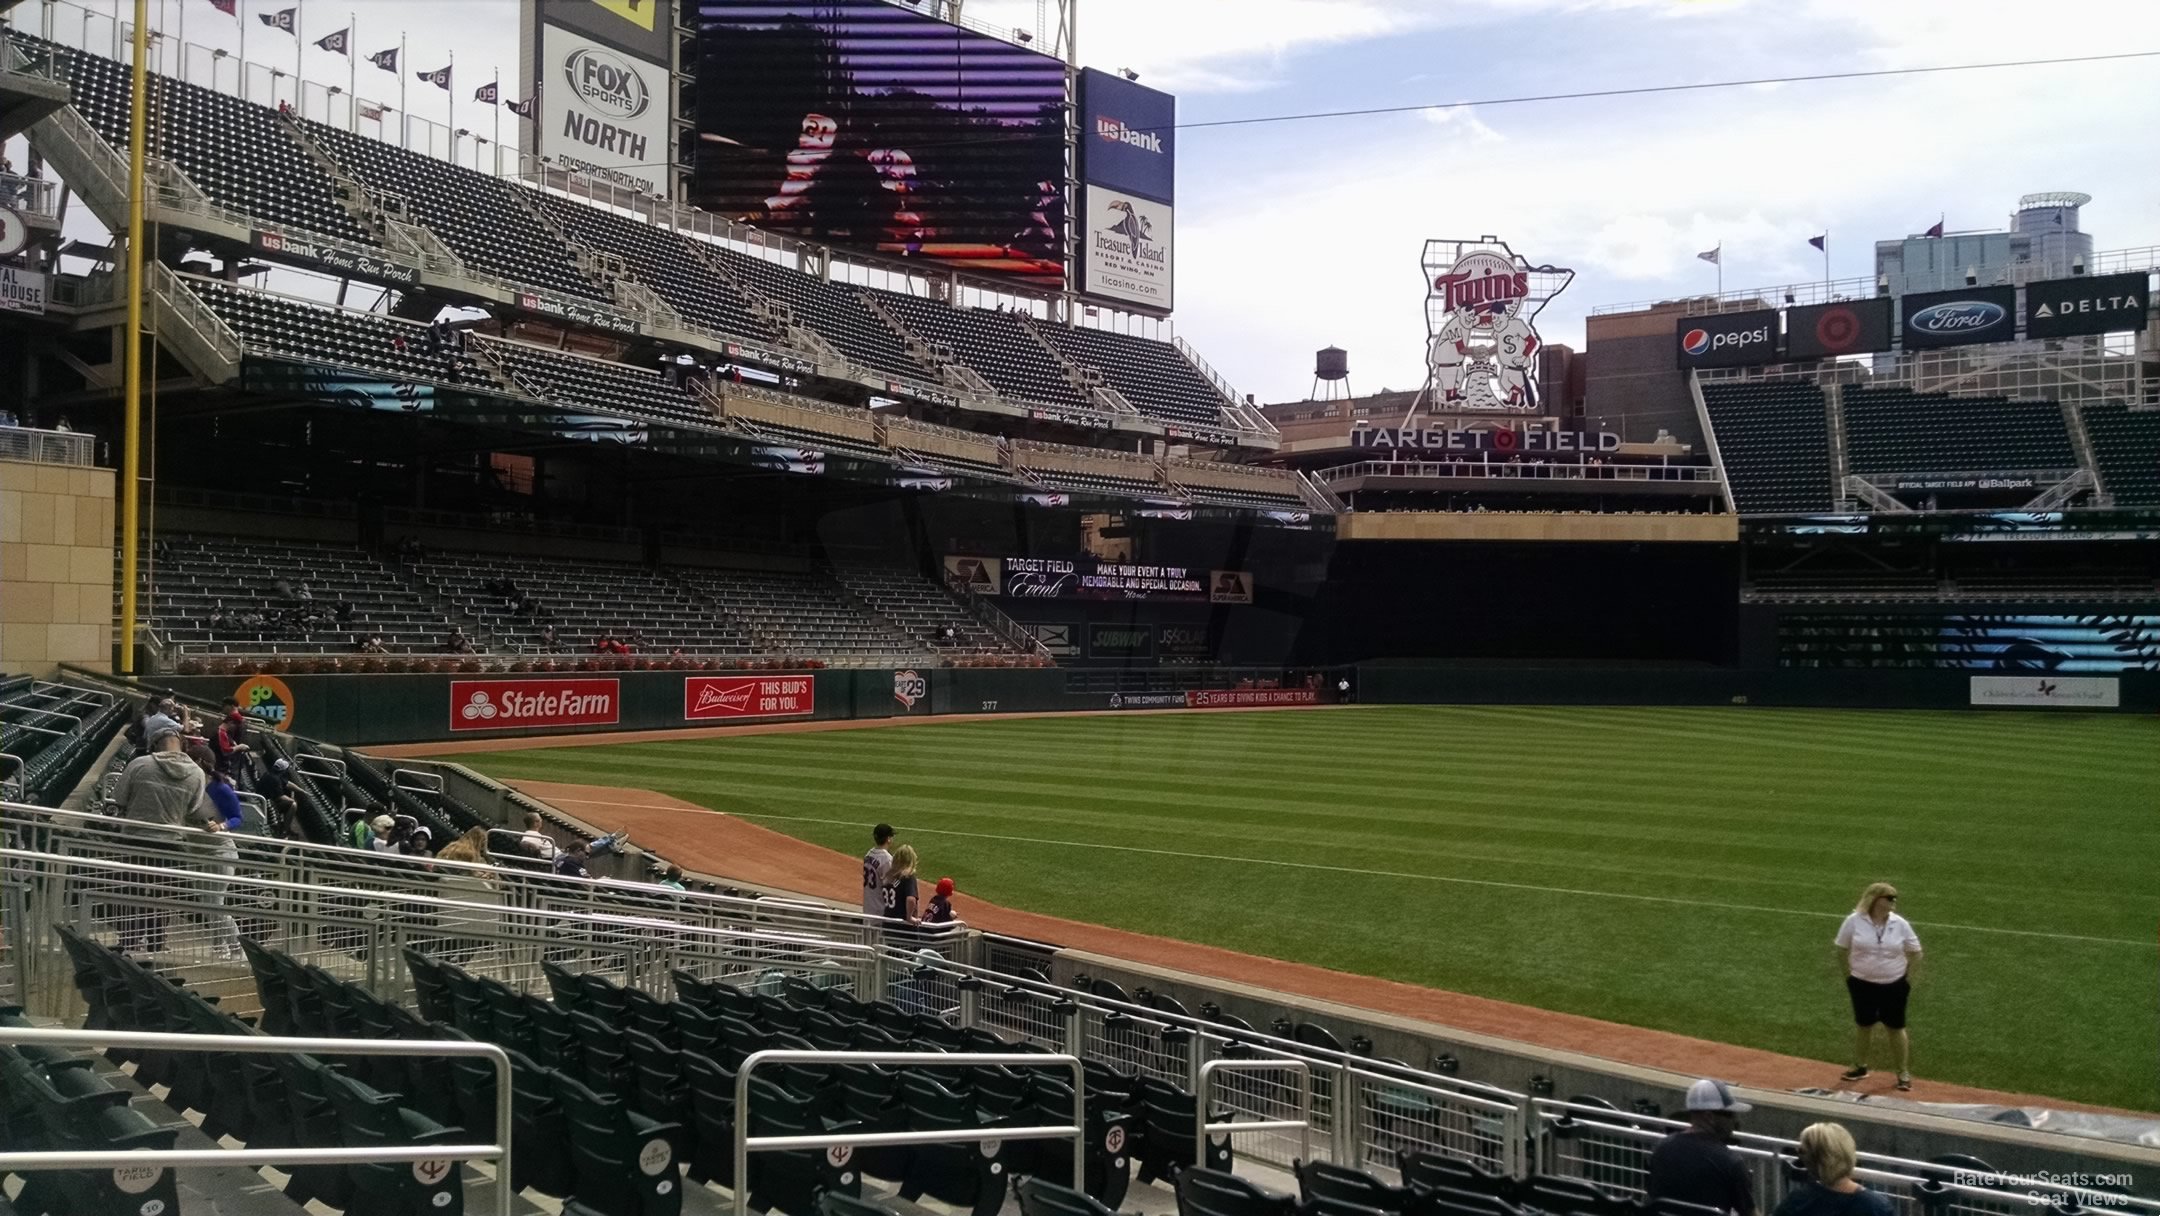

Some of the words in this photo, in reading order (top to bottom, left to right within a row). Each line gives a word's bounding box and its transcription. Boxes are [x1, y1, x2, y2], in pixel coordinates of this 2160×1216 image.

[584, 56, 632, 99] FOX
[583, 85, 632, 111] SPORTS
[564, 110, 647, 161] NORTH
[1094, 231, 1131, 255] Treasure
[1139, 243, 1165, 263] Island
[322, 249, 353, 269] Home
[358, 258, 379, 275] Run
[383, 264, 412, 282] Porch
[1095, 252, 1124, 262] RESORT
[1136, 261, 1164, 271] CASINO
[1102, 275, 1157, 295] ticasino.com
[1435, 267, 1529, 313] Twins
[2060, 295, 2139, 315] DELTA
[567, 307, 590, 323] Home
[593, 313, 611, 327] Run
[612, 318, 635, 333] Porch
[1928, 308, 1985, 329] Ford
[1713, 326, 1768, 350] pepsi
[1352, 428, 1489, 449] TARGET
[1524, 431, 1622, 451] FIELD
[1991, 478, 2032, 489] Ballpark
[1006, 558, 1045, 572] TARGET
[1046, 560, 1073, 573] FIELD
[1097, 564, 1117, 576] MAKE
[1119, 565, 1136, 577] YOUR
[1137, 566, 1158, 577] EVENT
[1160, 567, 1165, 577] A
[1167, 568, 1187, 578] TRULY
[1008, 573, 1079, 597] Events
[1082, 576, 1124, 588] MEMORABLE
[1126, 578, 1139, 588] AND
[1141, 579, 1168, 590] SPECIAL
[1092, 631, 1146, 647] SUBWAY
[249, 686, 272, 705] go
[700, 690, 750, 704] Budweiser
[760, 682, 780, 695] THIS
[782, 681, 807, 695] BUD'S
[906, 680, 924, 696] 29
[760, 697, 777, 710] FOR
[779, 697, 798, 710] YOU.
[982, 701, 998, 710] 377
[1124, 696, 1140, 704] TWINS
[1142, 696, 1171, 704] COMMUNITY
[1196, 692, 1209, 705] 25
[1209, 693, 1228, 703] YEARS
[1229, 693, 1236, 702] OF
[1237, 693, 1254, 702] GIVING
[1255, 693, 1268, 702] KIDS
[1273, 692, 1293, 701] CHANCE
[882, 887, 896, 908] 33
